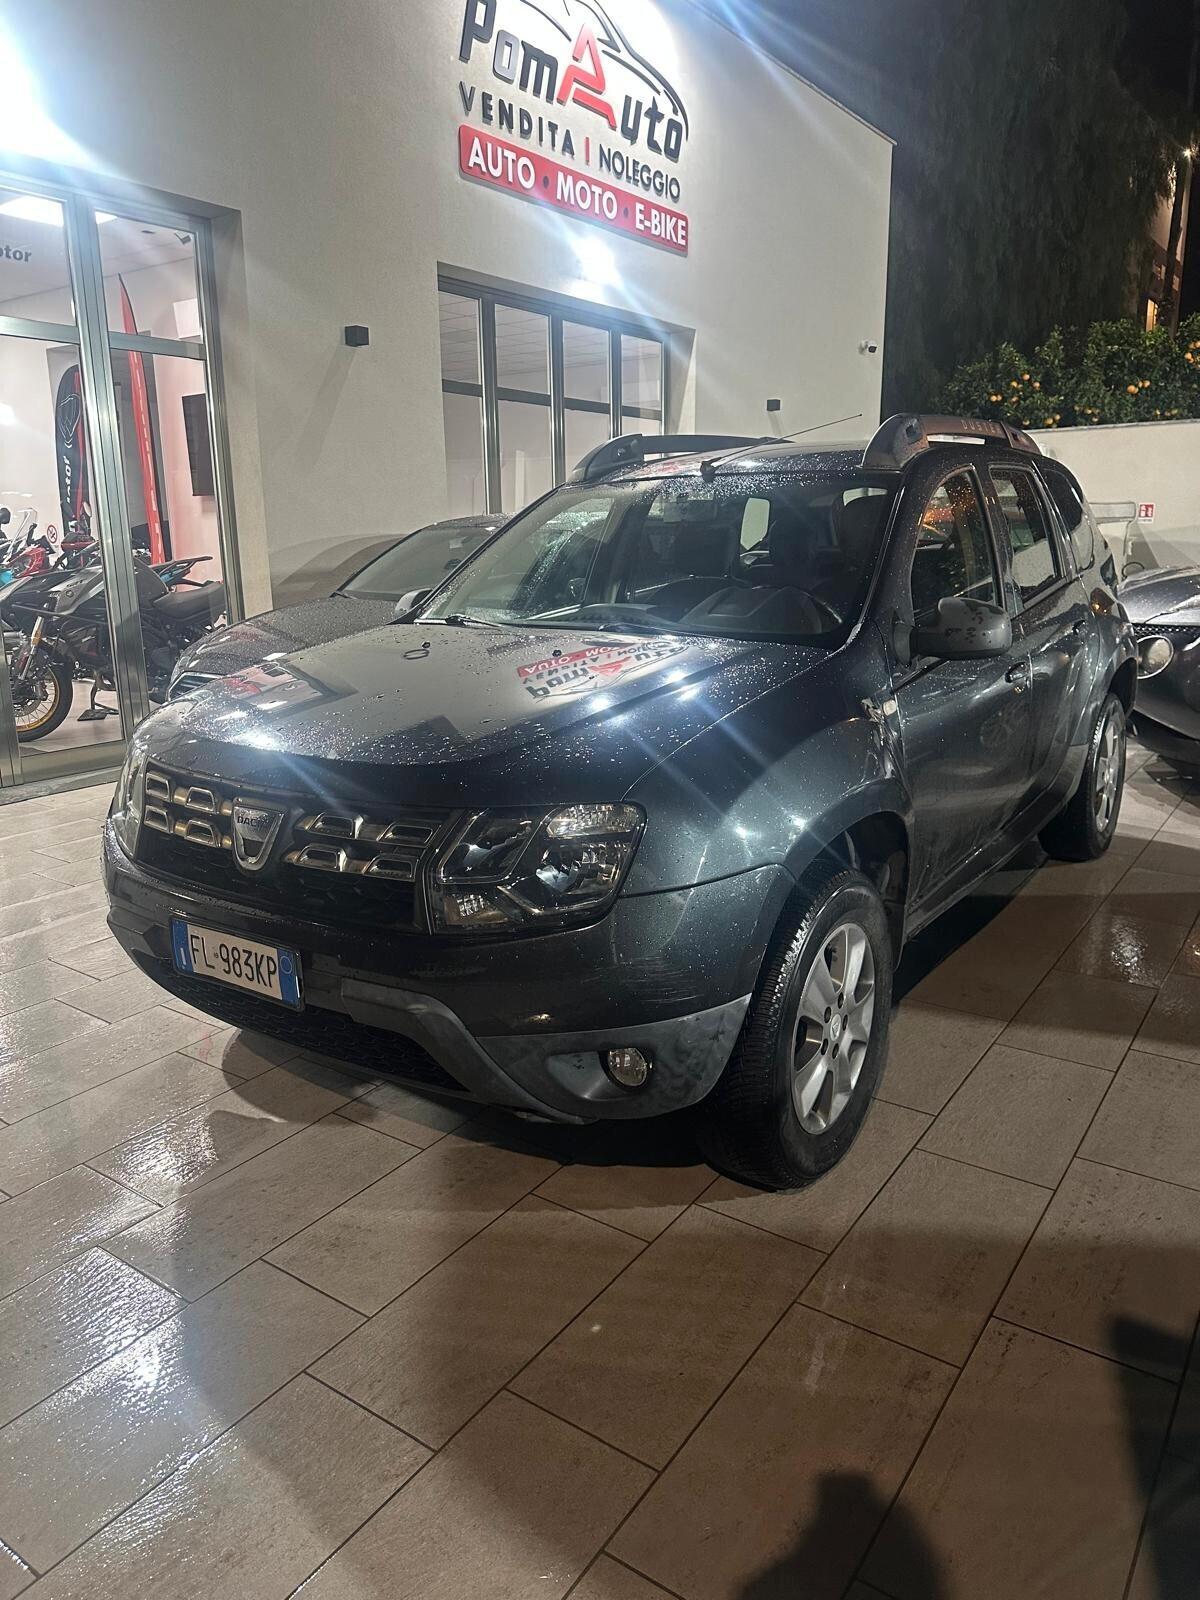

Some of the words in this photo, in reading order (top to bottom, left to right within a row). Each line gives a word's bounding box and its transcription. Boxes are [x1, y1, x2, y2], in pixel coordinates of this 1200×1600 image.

[458, 81, 575, 159] VENDITA
[599, 143, 681, 202] NOLEGGIO
[468, 136, 536, 190] AUTO
[556, 171, 618, 220] MOTO
[635, 201, 687, 246] E-BIKE
[237, 815, 269, 829] DAC
